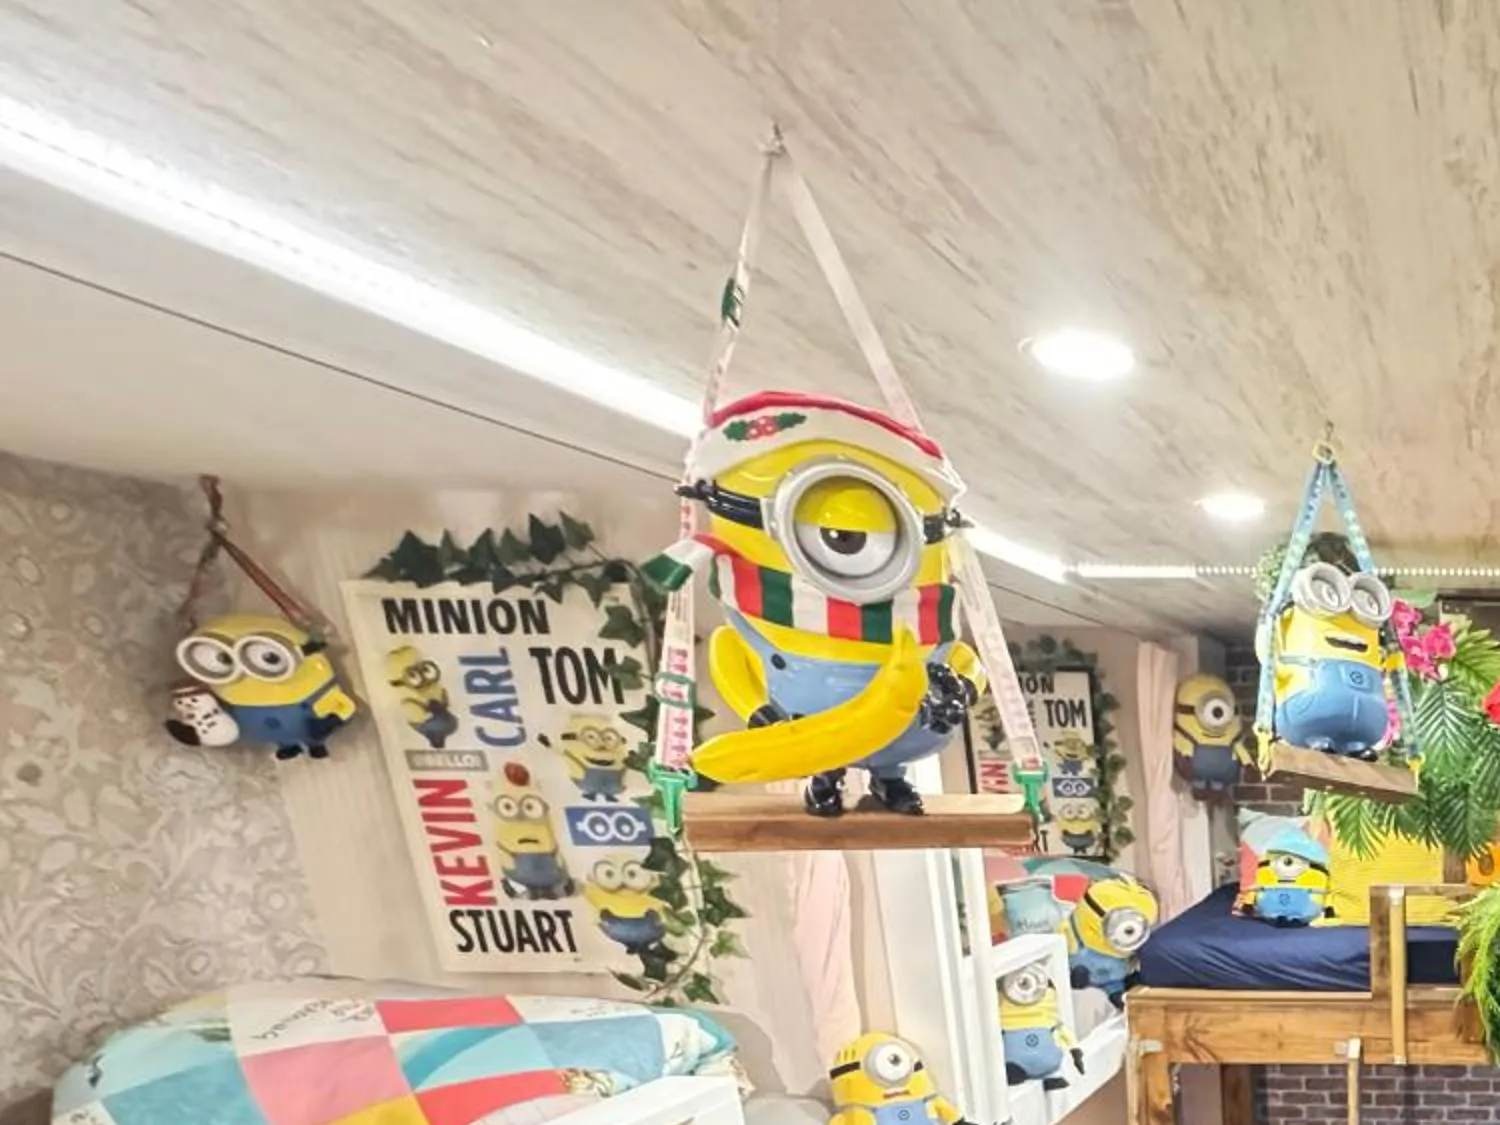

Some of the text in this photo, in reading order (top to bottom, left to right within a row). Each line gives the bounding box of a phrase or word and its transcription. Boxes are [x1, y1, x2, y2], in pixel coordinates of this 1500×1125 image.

[382, 598, 551, 635] MINION
[458, 646, 527, 747] CARL
[530, 647, 626, 705] TOM
[1043, 698, 1087, 729] TOM
[413, 779, 498, 907] KEVIN
[449, 909, 579, 954] STUART
